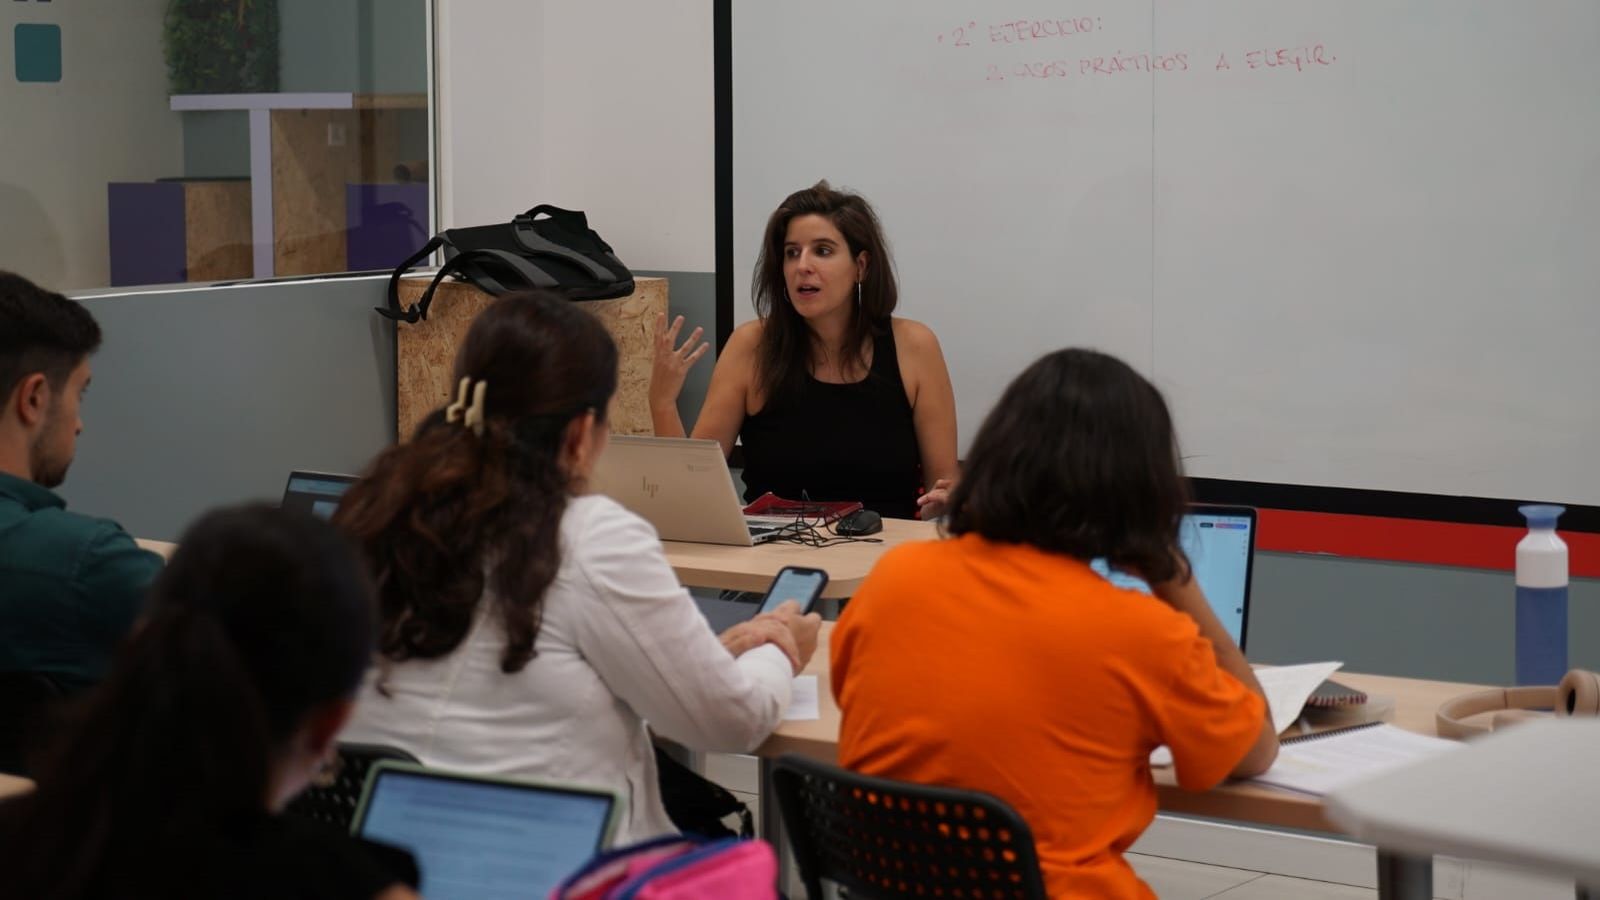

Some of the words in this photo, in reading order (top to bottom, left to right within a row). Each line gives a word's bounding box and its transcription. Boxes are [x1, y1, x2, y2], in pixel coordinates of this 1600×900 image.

[989, 15, 1103, 43] EJERCICIO:
[1013, 60, 1067, 79] CASOS
[1079, 49, 1189, 75] PRÁCTICOS
[1215, 53, 1231, 71] A
